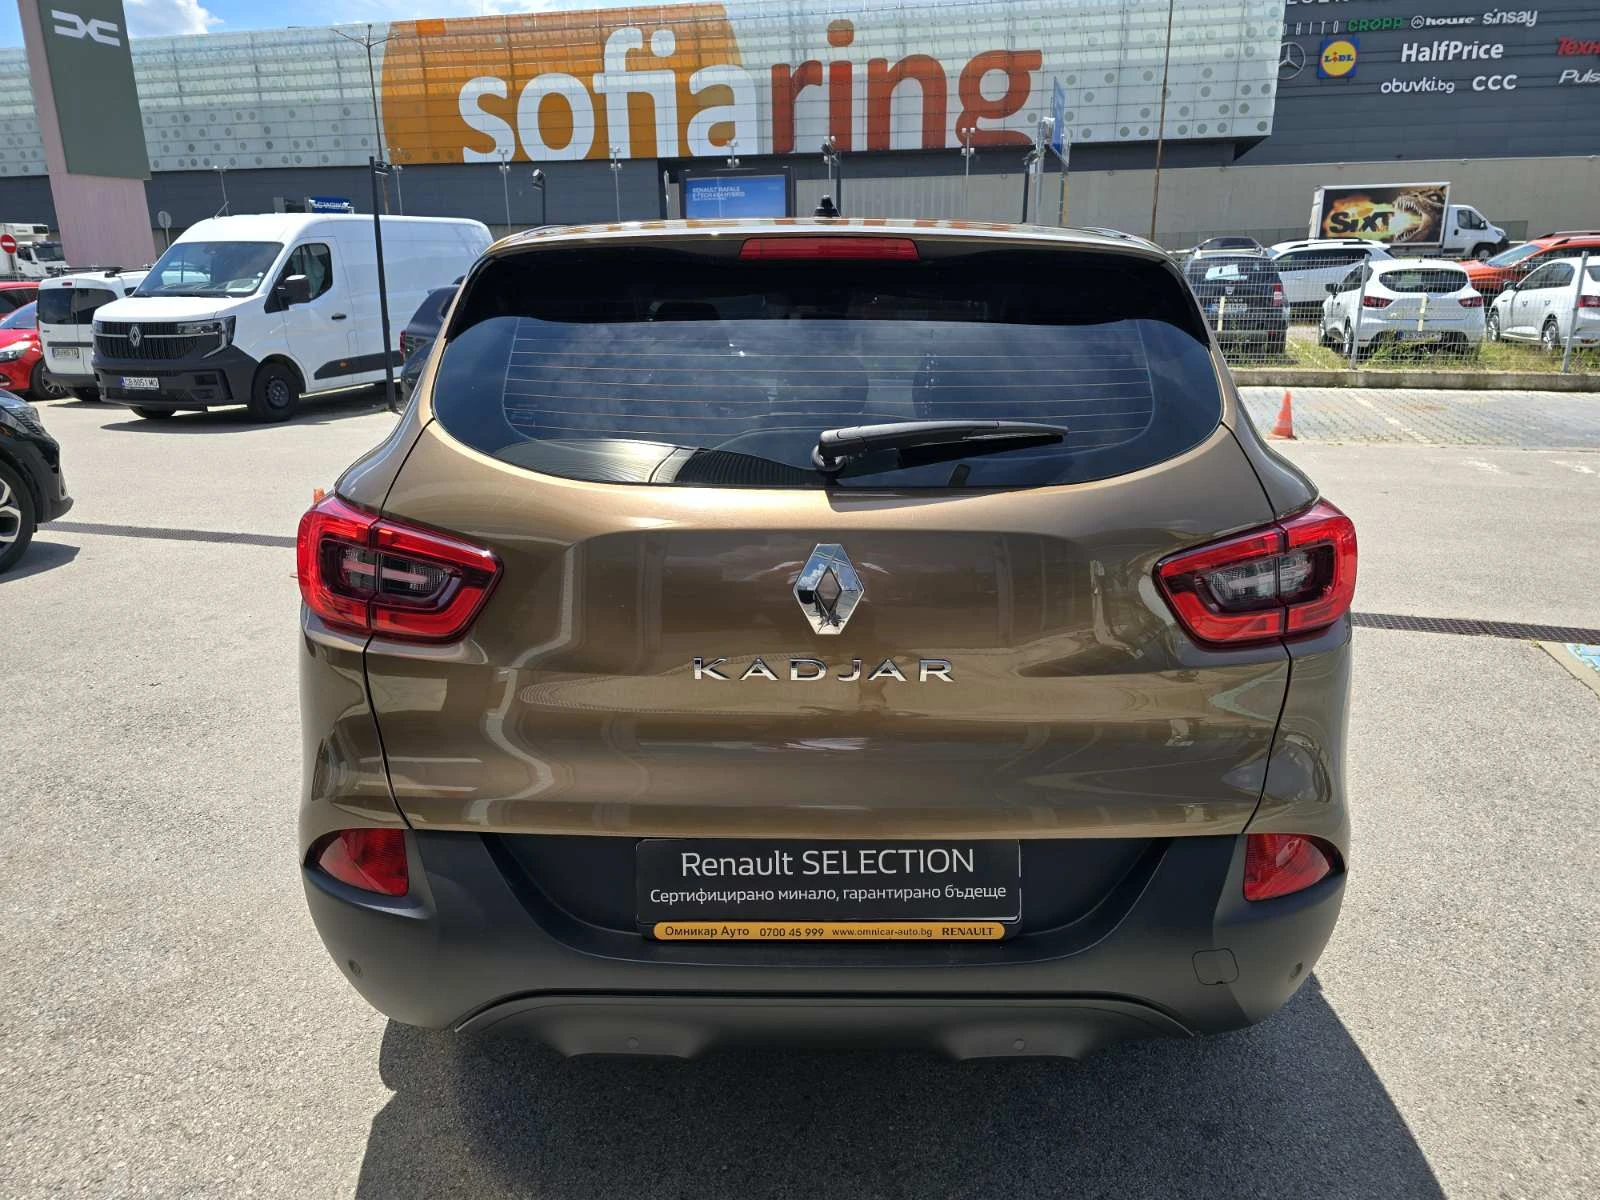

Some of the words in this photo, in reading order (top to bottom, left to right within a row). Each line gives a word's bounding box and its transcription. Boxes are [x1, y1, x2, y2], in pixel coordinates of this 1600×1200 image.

[1482, 8, 1538, 27] sinsay
[1400, 40, 1504, 62] HalfPrice
[1380, 76, 1455, 94] obuvki.bg
[1472, 74, 1518, 91] CCC
[692, 657, 955, 682] KADJAR
[681, 850, 794, 877] Renault
[802, 848, 974, 876] SELECTION
[650, 888, 775, 906] Сертифицирано
[778, 889, 840, 902] минало,
[843, 888, 941, 903] гарантирано
[944, 884, 1007, 900] бъдеще
[665, 926, 718, 938] Омникар
[721, 926, 750, 938] Ауто
[759, 927, 786, 937] 0700
[788, 927, 802, 936] 45
[804, 926, 825, 937] 999
[831, 926, 933, 938] www.omnicar-auto.bg
[941, 926, 995, 937] RENAULT
